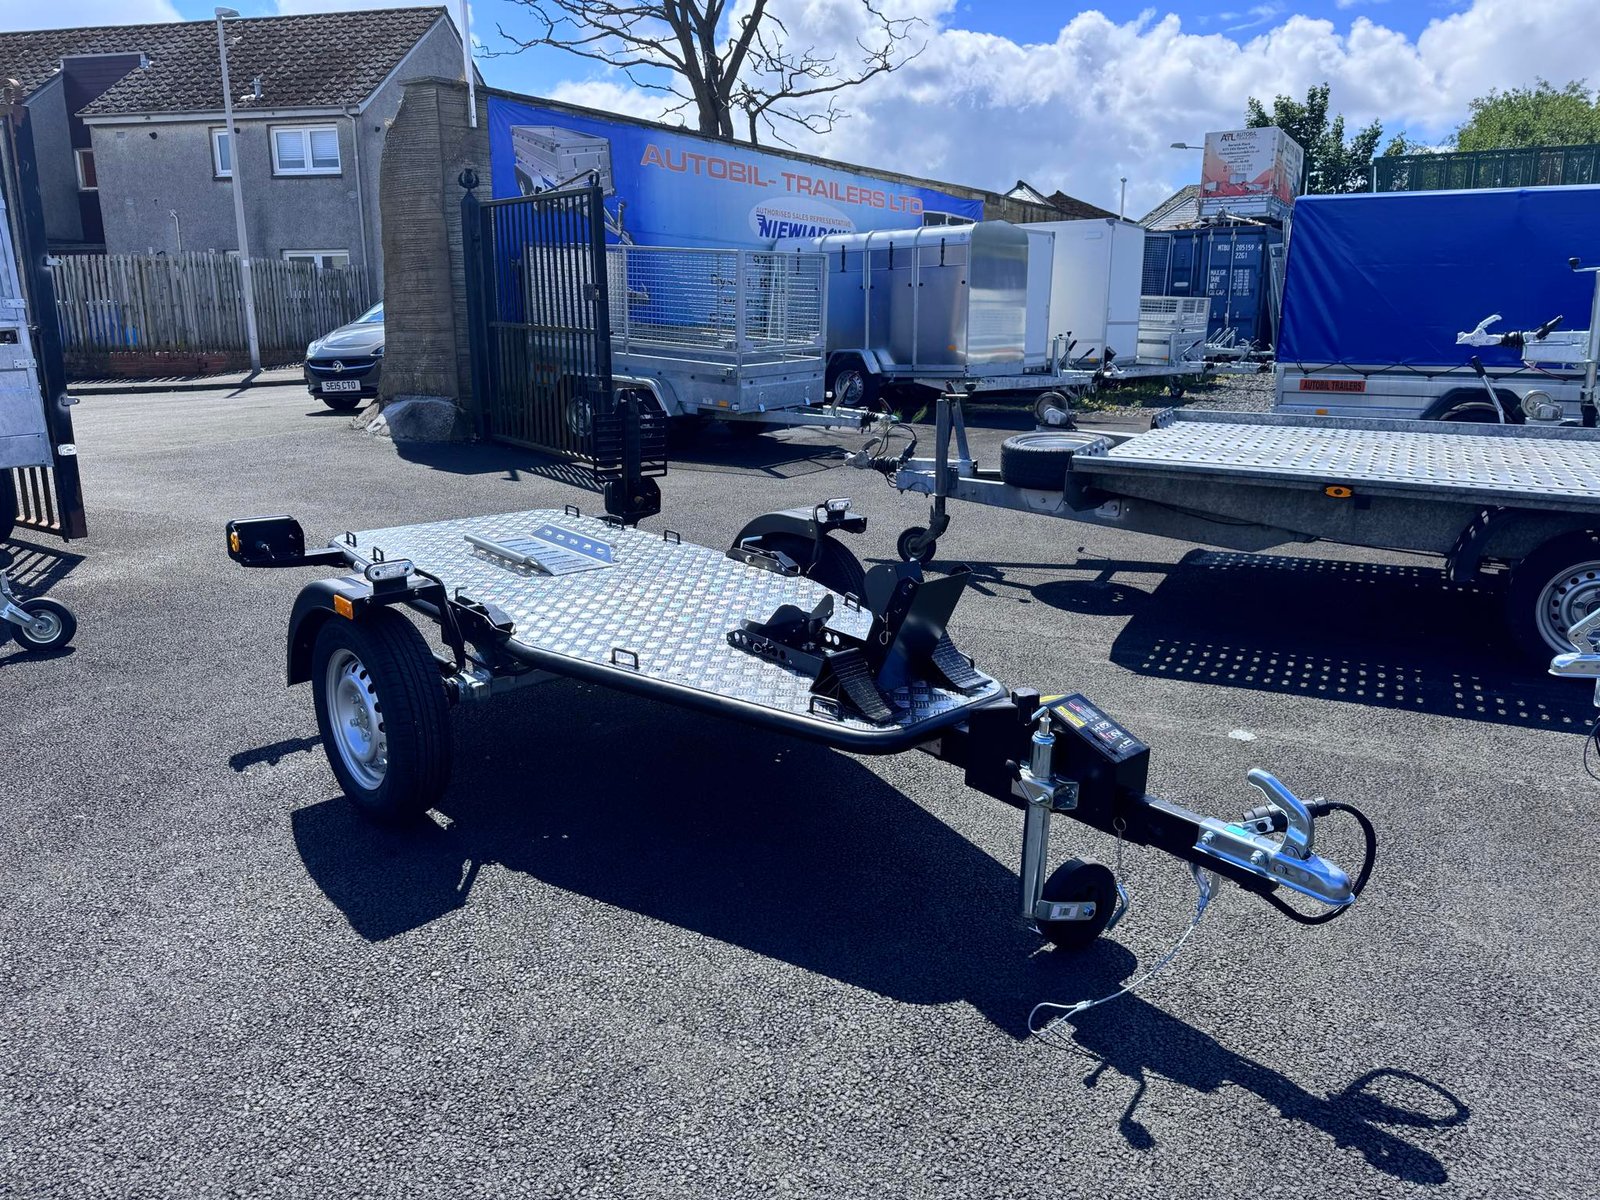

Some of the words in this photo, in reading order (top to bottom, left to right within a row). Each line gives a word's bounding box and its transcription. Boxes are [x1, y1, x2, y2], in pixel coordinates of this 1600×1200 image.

[780, 172, 885, 209] TRAILERS
[888, 193, 924, 216] LTD
[755, 207, 791, 219] AUTHORISED
[792, 212, 809, 222] SALES
[809, 215, 852, 228] REPRESENTATIVE
[341, 381, 356, 390] CTO
[1303, 380, 1329, 391] AUTOBIL
[1331, 381, 1362, 392] TRAILERS
